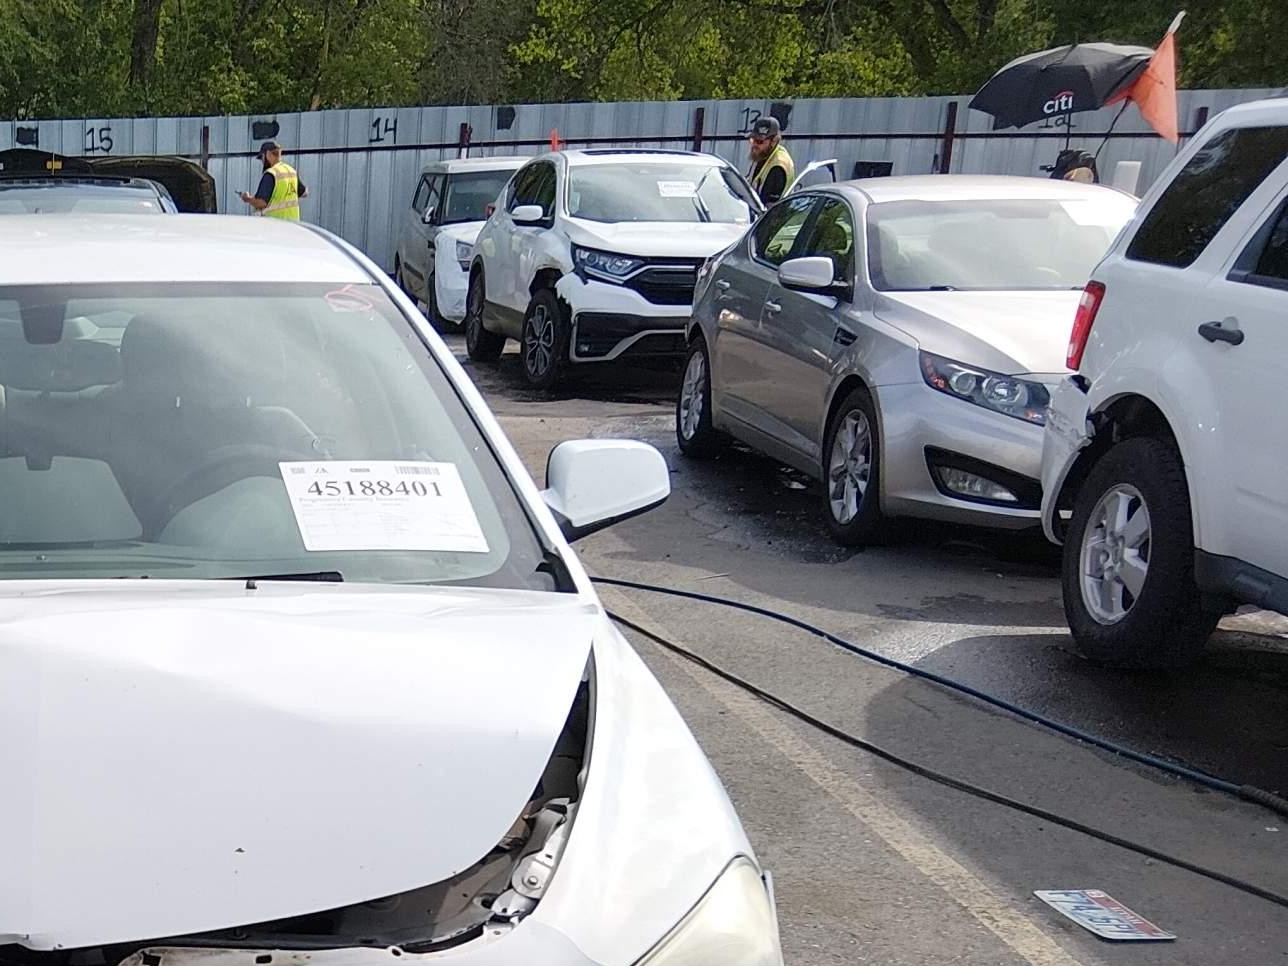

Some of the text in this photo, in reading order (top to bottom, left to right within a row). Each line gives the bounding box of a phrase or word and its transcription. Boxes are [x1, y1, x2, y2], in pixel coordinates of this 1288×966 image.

[1043, 94, 1074, 114] citi
[84, 127, 114, 153] 15
[368, 117, 398, 145] 14
[307, 480, 443, 497] 45188401
